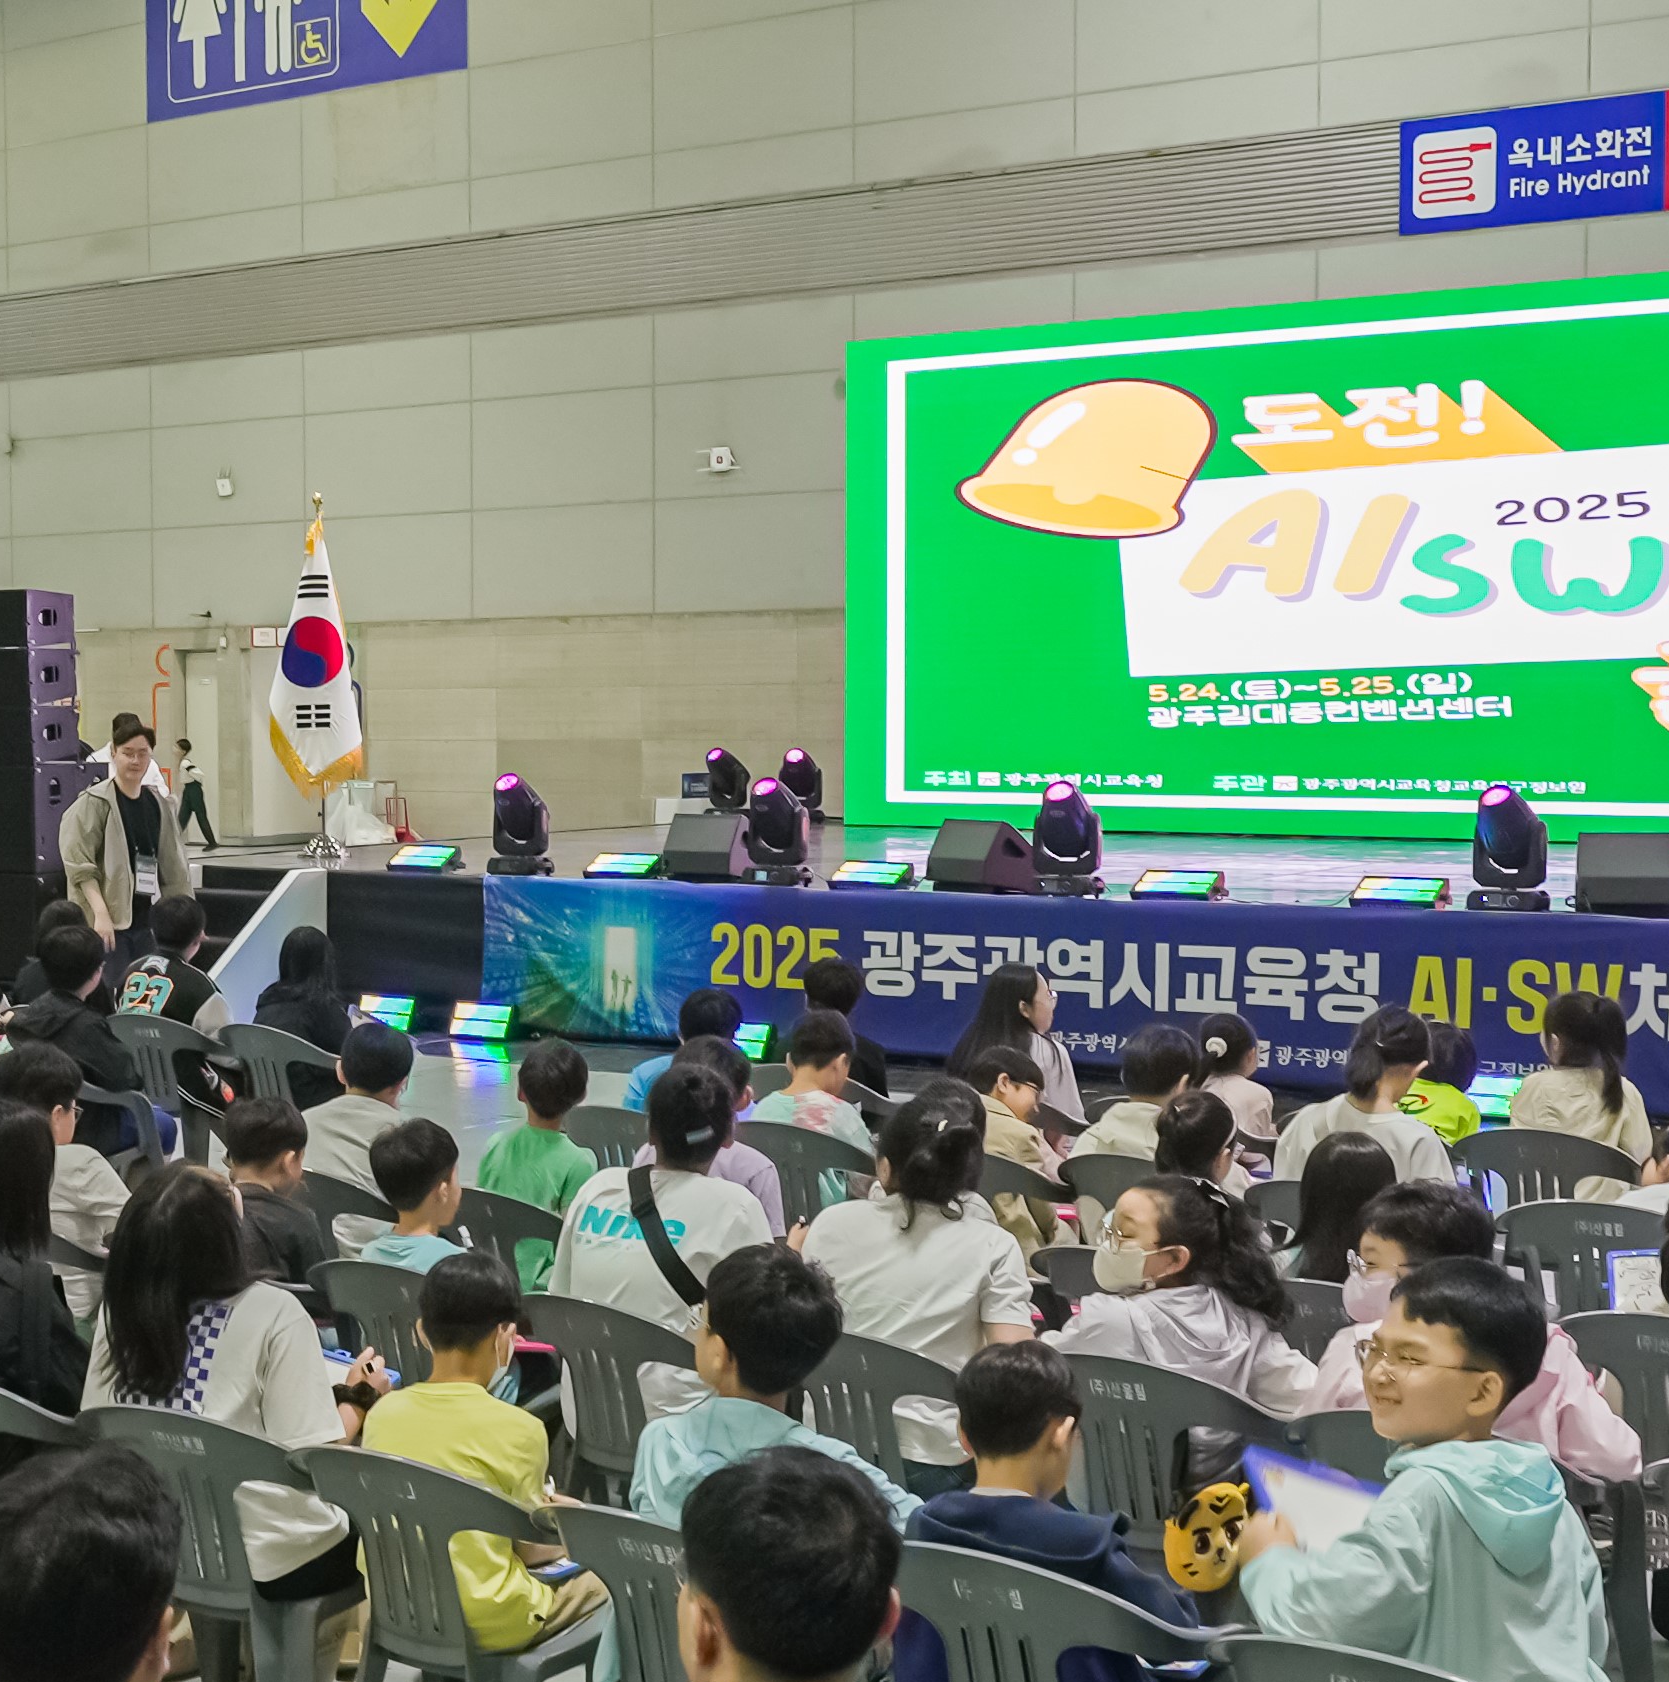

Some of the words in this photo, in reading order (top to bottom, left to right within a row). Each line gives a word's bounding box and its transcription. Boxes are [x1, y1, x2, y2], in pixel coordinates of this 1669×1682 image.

[1507, 126, 1652, 169] 옥내소화전
[1509, 176, 1551, 200] Fire
[1558, 165, 1651, 196] Hydrant
[1231, 380, 1486, 449] 도전!
[1496, 490, 1651, 527] 2025
[1147, 696, 1513, 728] 광주김대중컨벤션센터
[1213, 775, 1267, 792] 주관
[116, 970, 175, 1015] 23
[709, 921, 840, 991] 2025
[860, 929, 1380, 1027] 광주광역시교육청
